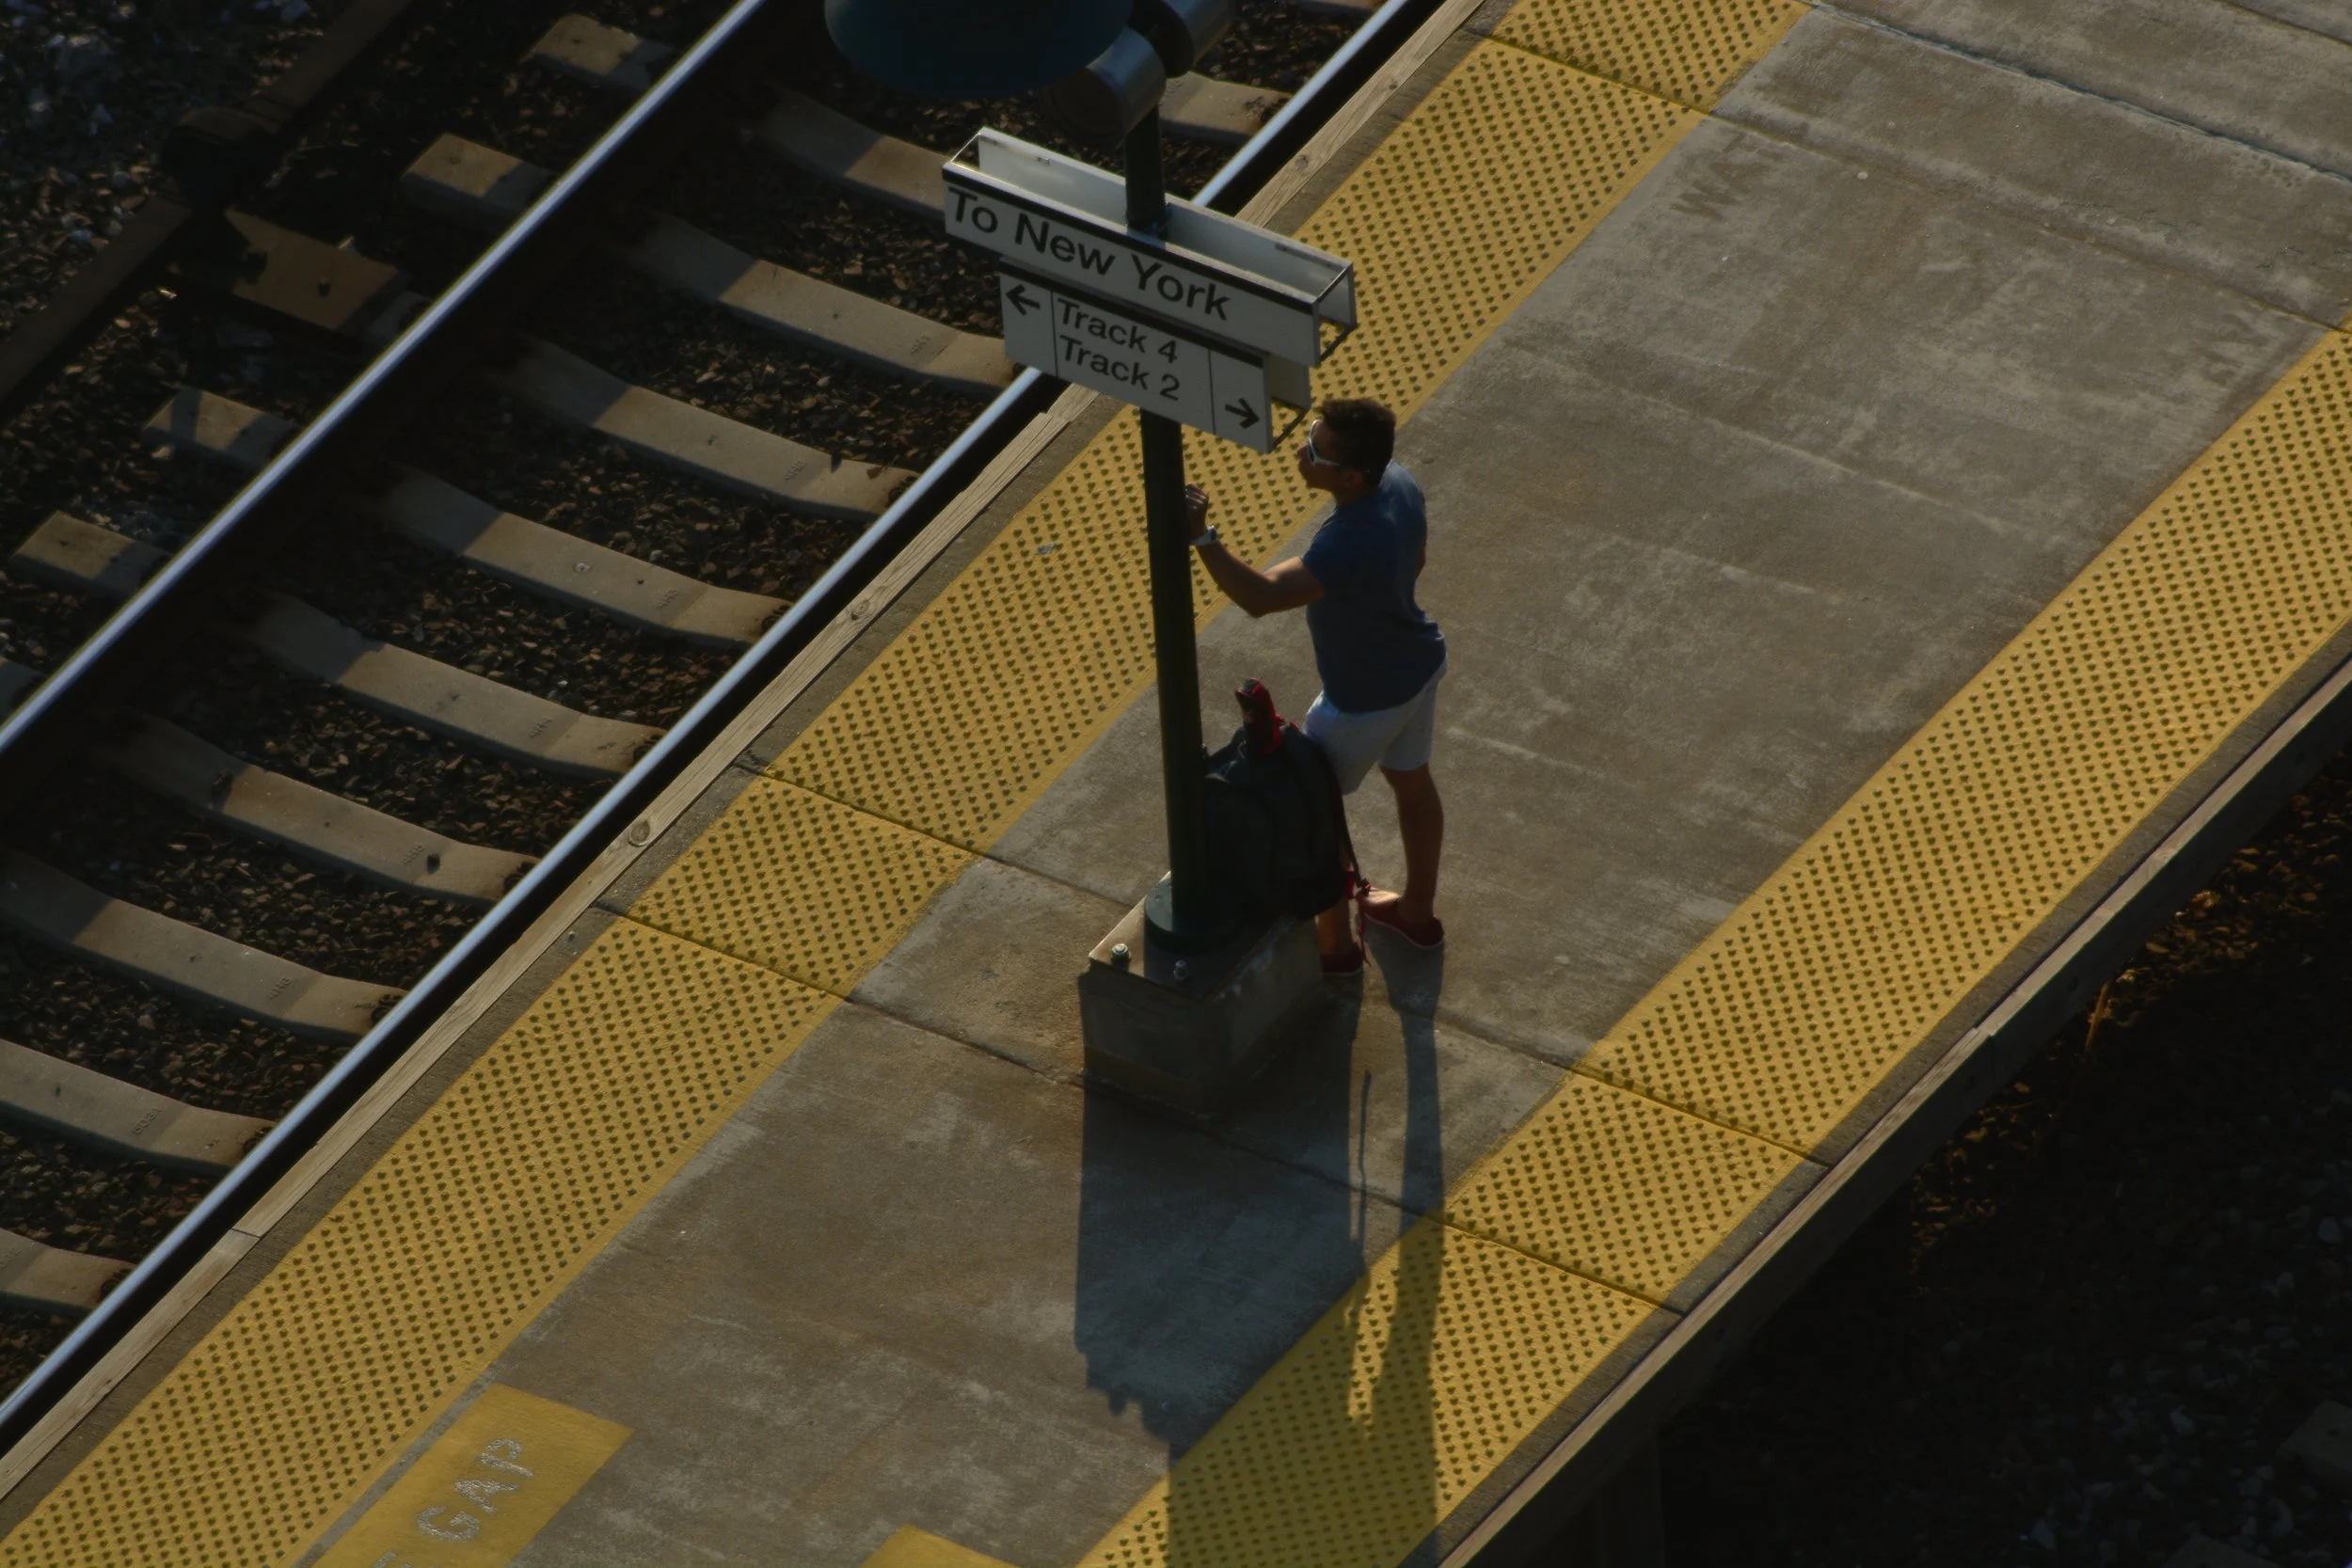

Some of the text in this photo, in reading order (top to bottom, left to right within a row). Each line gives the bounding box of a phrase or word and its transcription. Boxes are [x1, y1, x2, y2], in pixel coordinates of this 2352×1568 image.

[948, 186, 1232, 322] To New York
[1057, 297, 1178, 364] Track 4
[1059, 335, 1181, 401] Track 2
[417, 1437, 533, 1543] GAP
